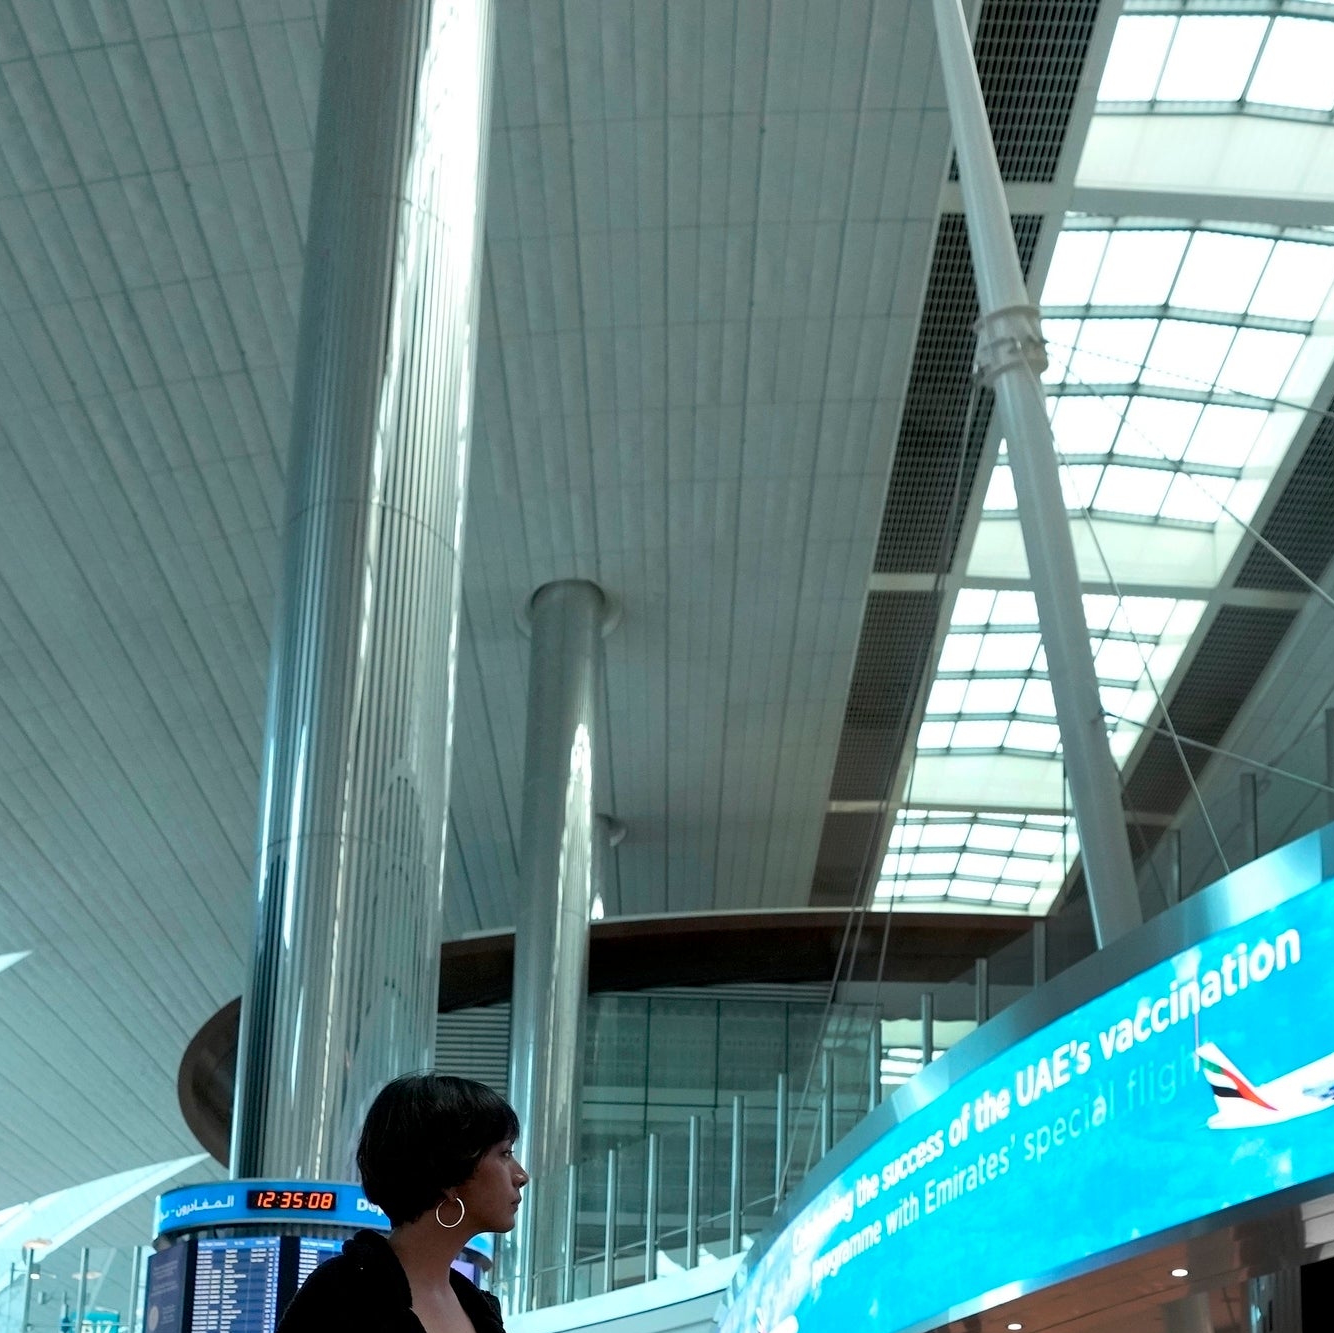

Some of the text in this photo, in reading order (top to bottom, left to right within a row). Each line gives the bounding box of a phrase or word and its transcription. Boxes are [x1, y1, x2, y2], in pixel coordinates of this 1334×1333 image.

[811, 1219, 882, 1290] programme
[886, 1192, 919, 1236] with
[925, 1133, 1015, 1215] Emirates'
[1024, 1083, 1114, 1163] special
[1127, 1046, 1201, 1110] fligh
[856, 928, 1301, 1208] the success of the UAE's vaccination
[257, 1191, 334, 1210] 12:35:08
